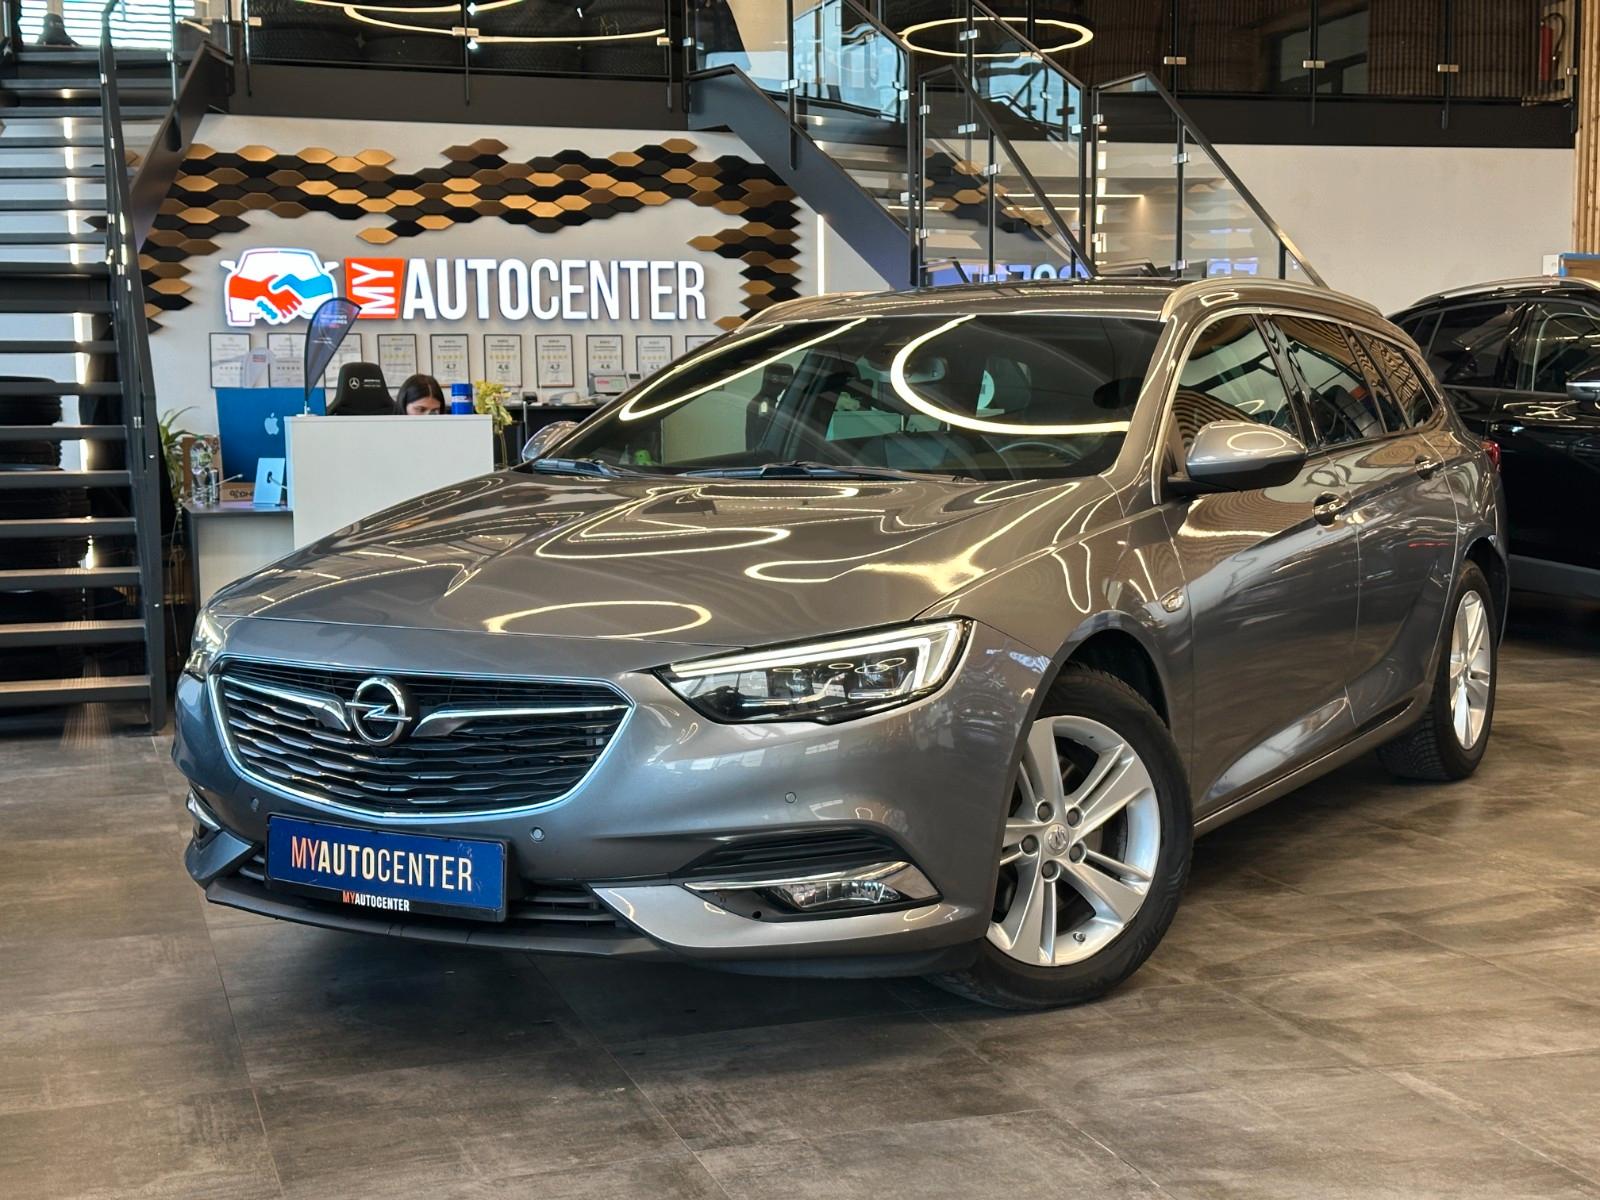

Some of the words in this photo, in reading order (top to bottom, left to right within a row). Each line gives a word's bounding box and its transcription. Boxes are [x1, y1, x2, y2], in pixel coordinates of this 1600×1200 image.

[351, 262, 396, 315] MY
[402, 258, 706, 320] AUTOCENTER
[291, 835, 473, 892] MYAUTOCENTER
[342, 890, 410, 912] MYAUTOCENTER
